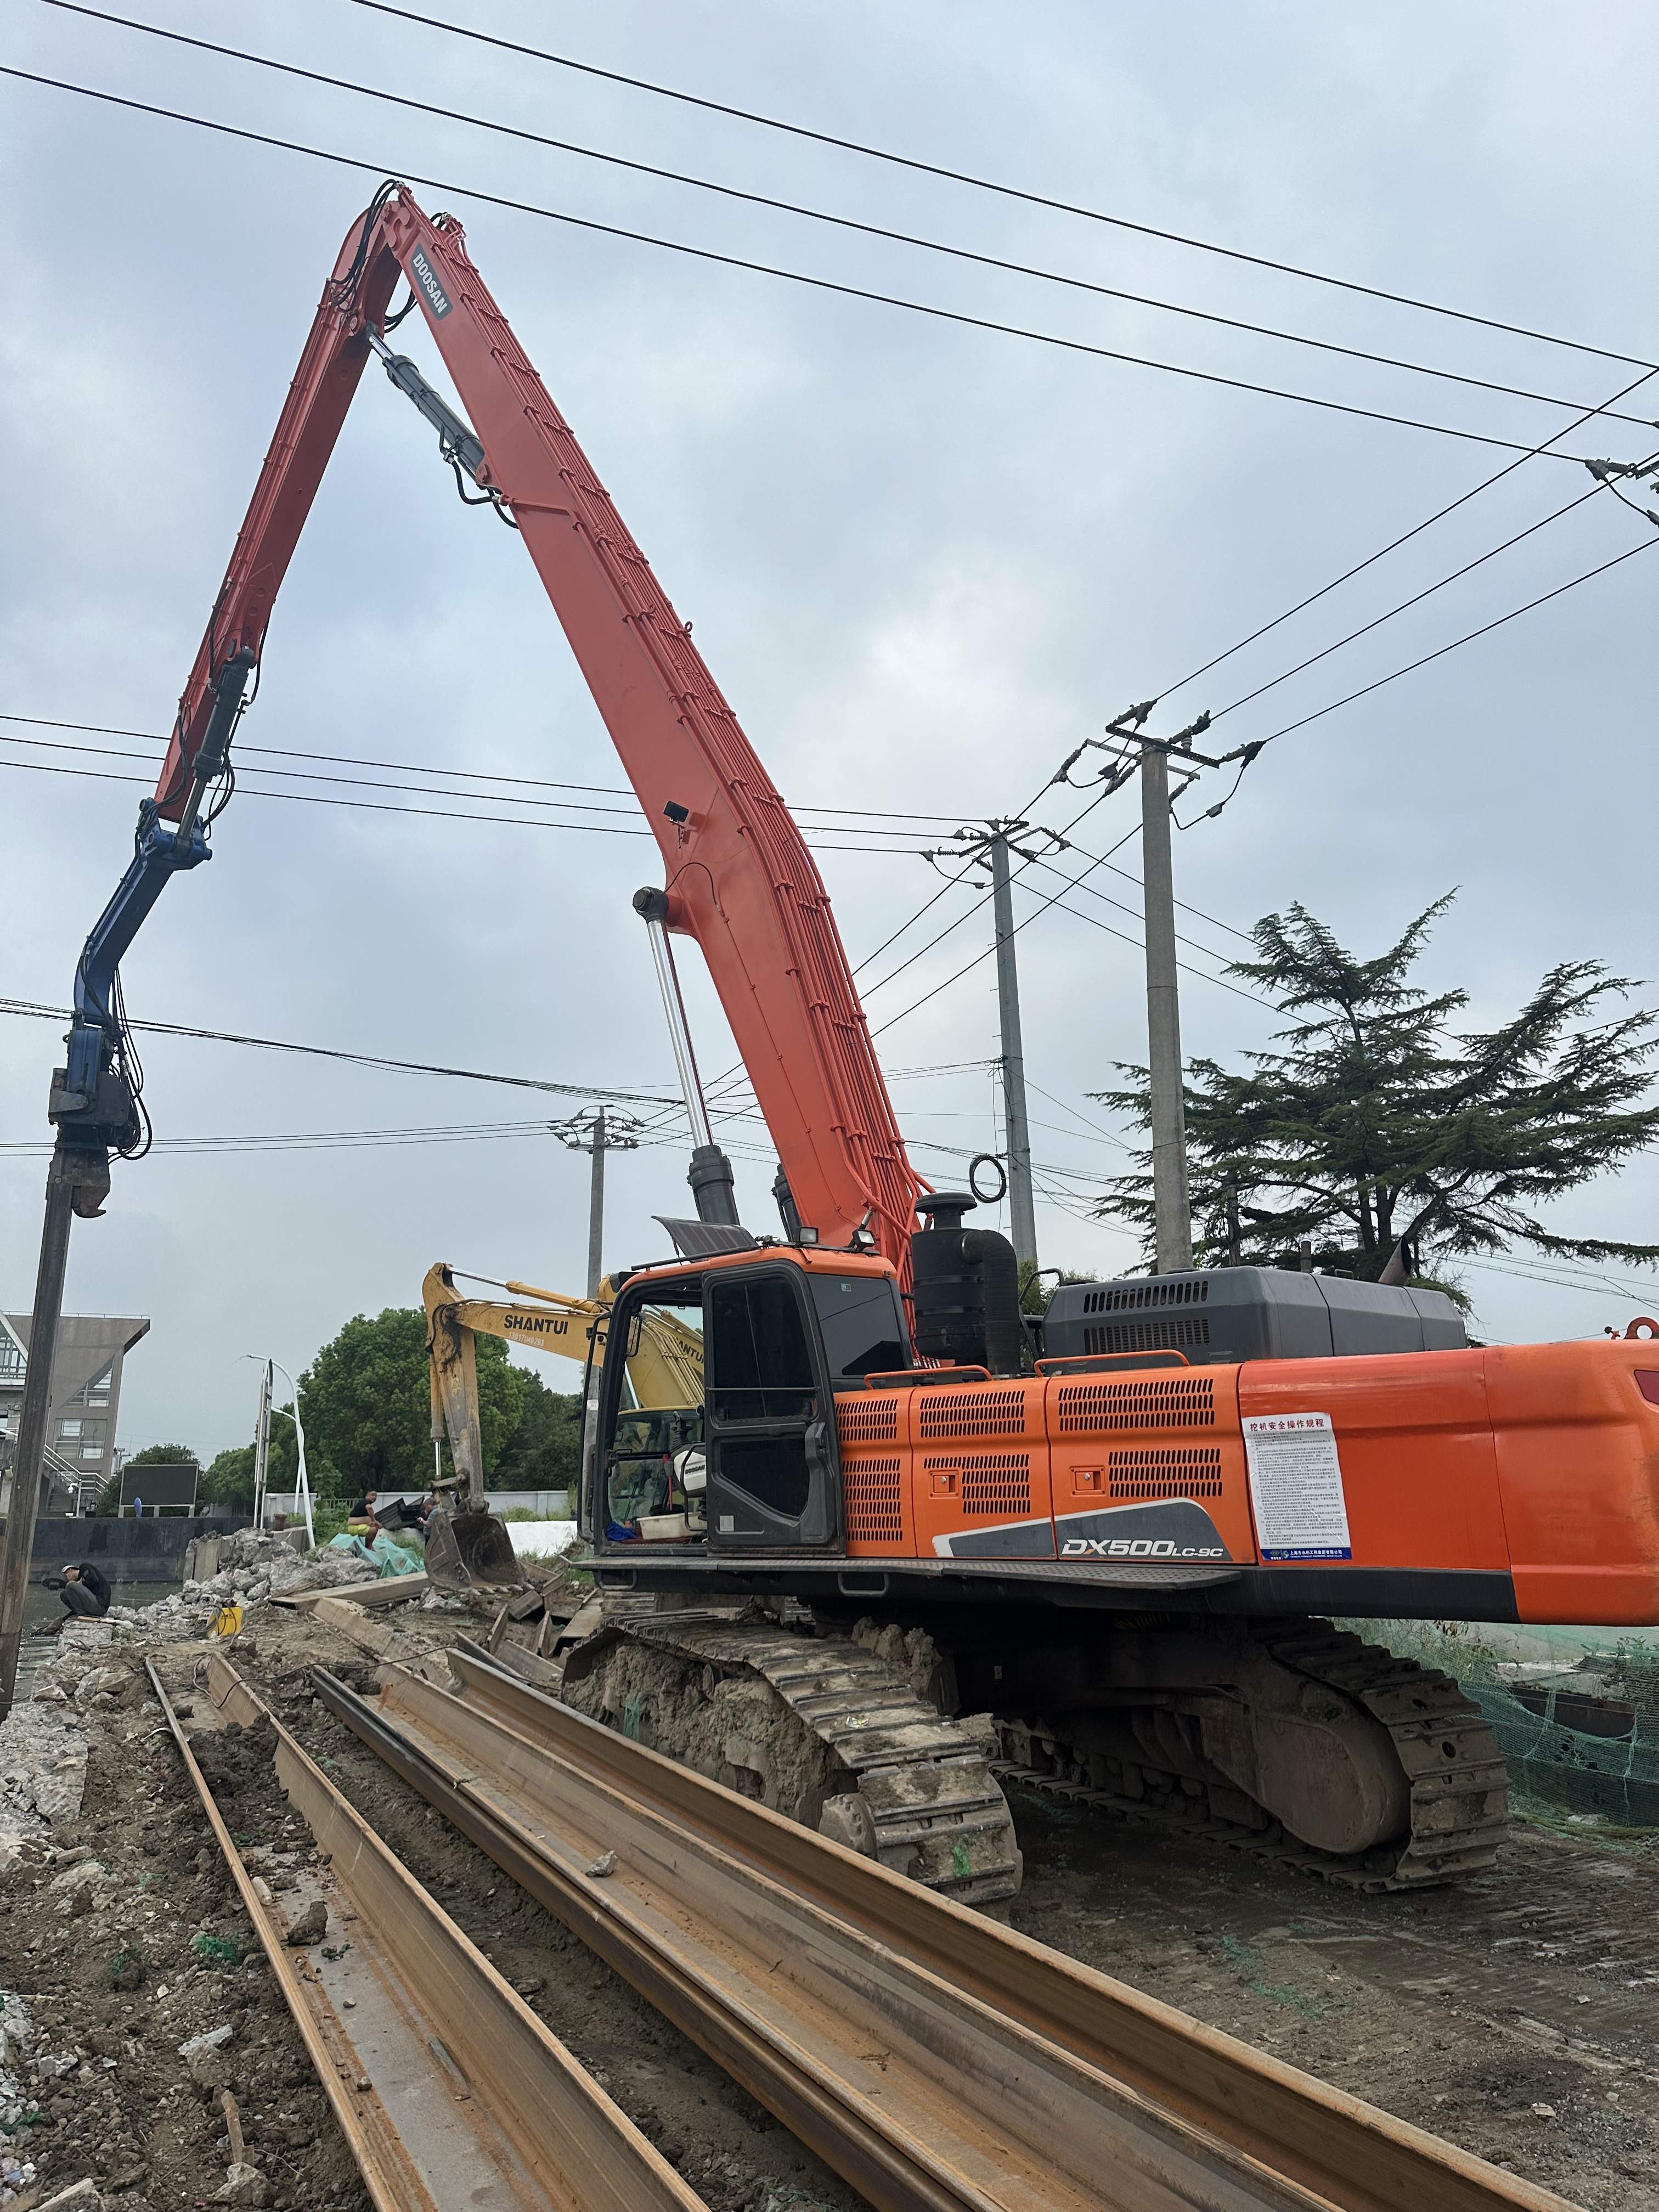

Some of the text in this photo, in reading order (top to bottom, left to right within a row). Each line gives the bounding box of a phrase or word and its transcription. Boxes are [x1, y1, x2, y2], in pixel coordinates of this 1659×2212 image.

[413, 253, 448, 314] DOOSAN
[504, 1314, 568, 1335] SHANTUI
[1250, 1419, 1324, 1431] 挖机安全操作规程
